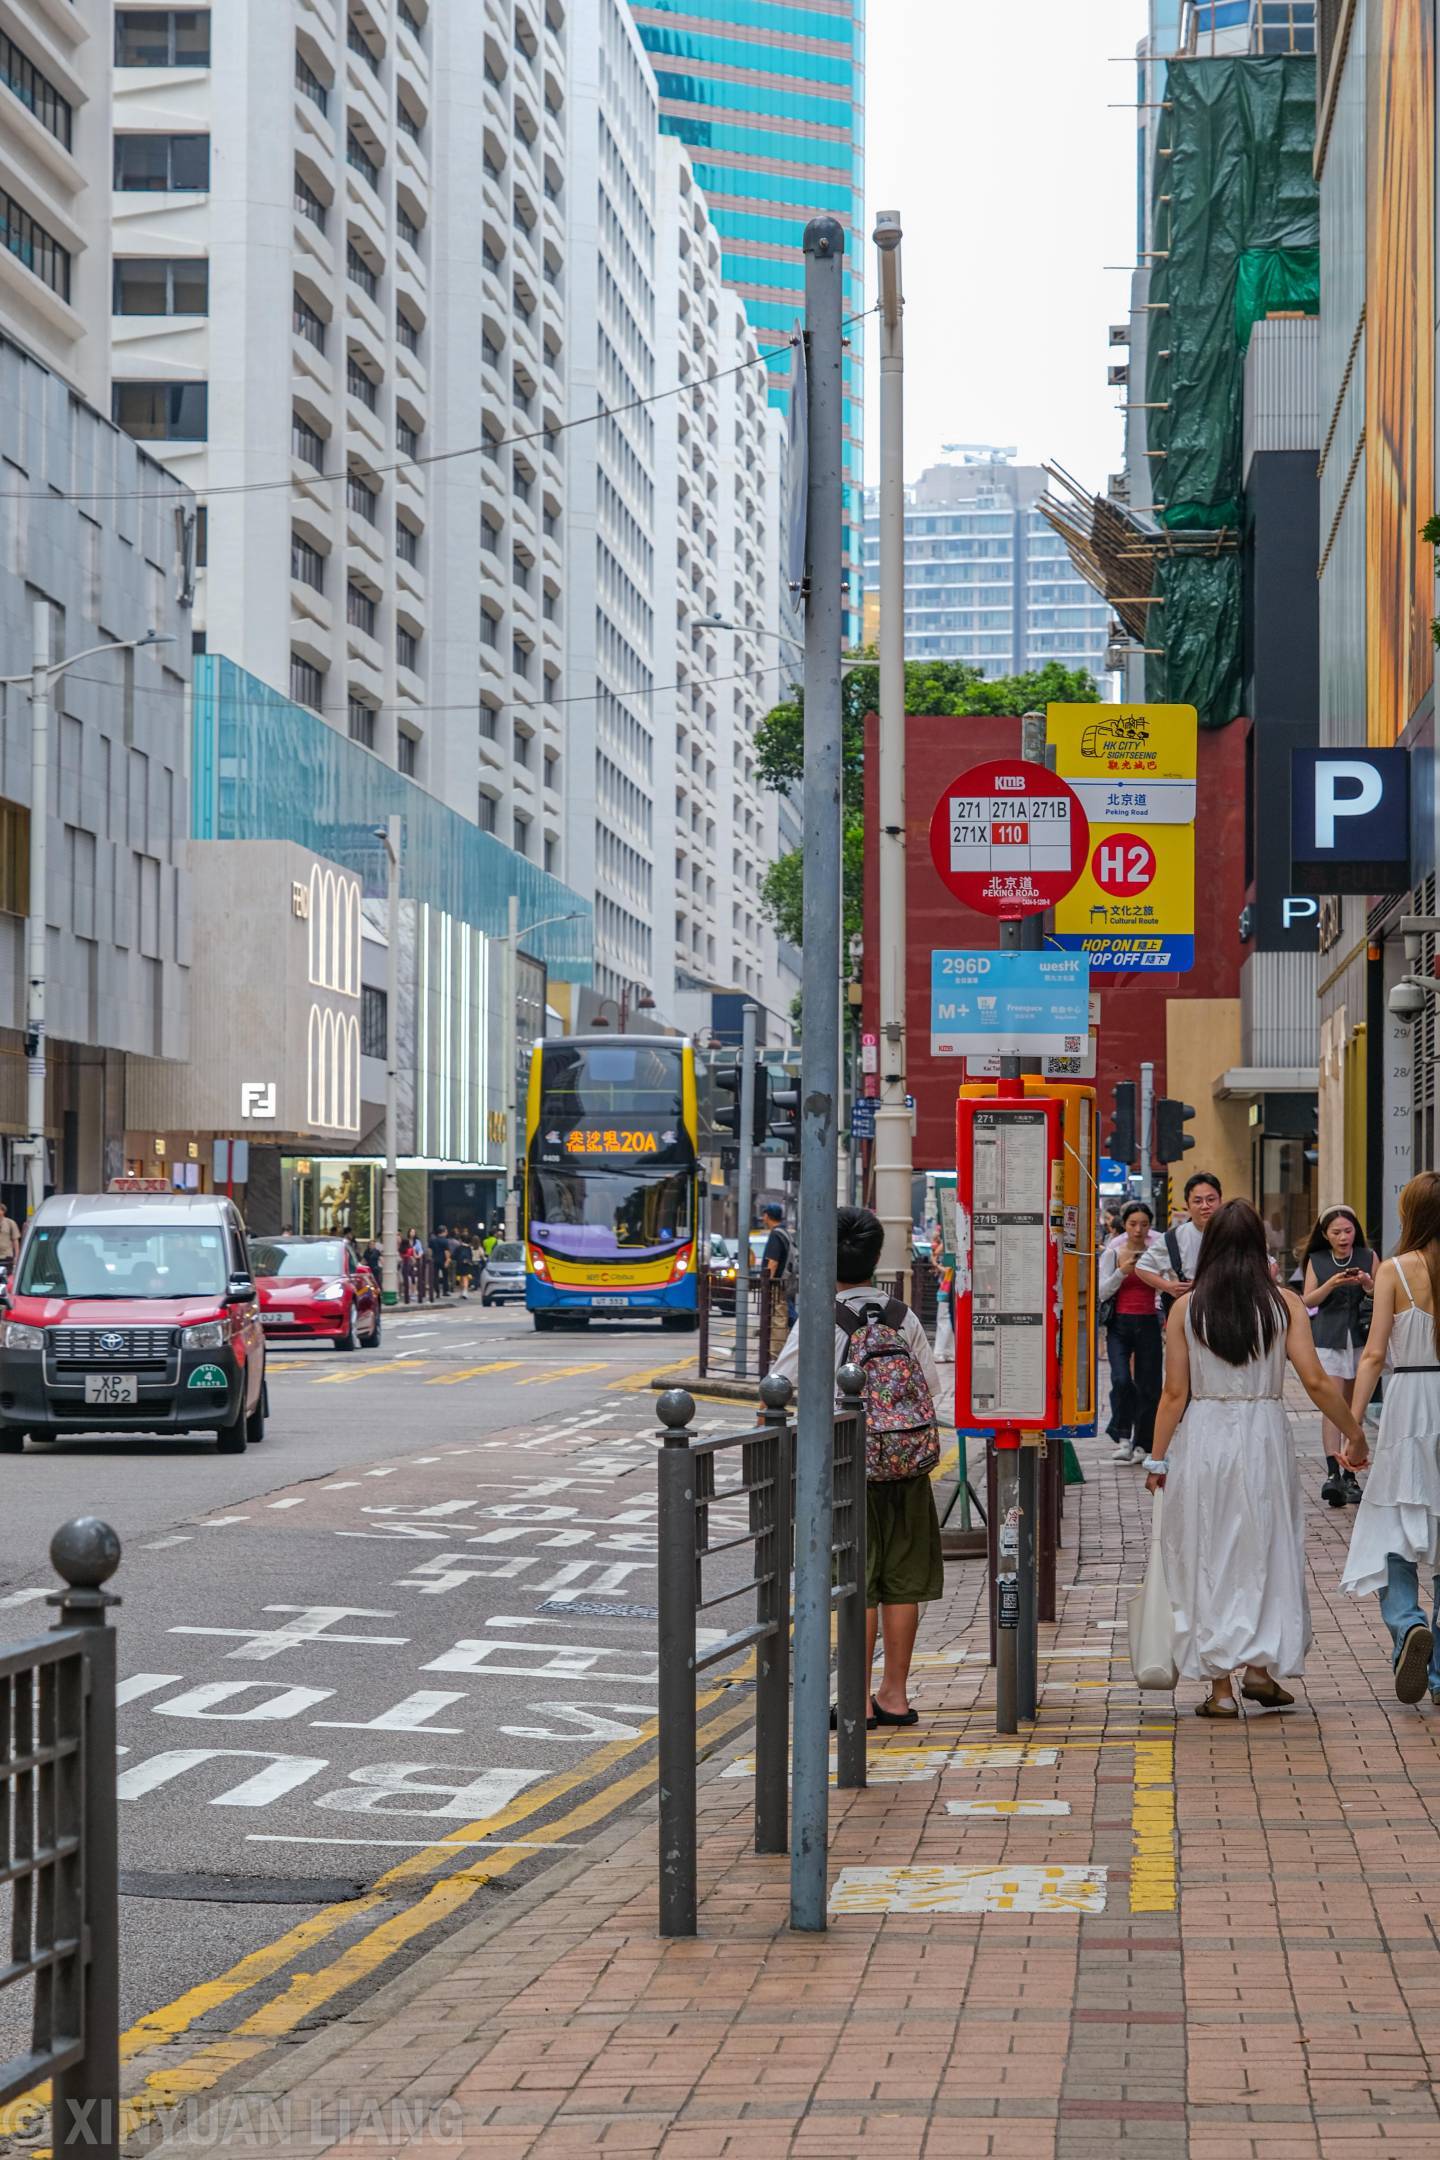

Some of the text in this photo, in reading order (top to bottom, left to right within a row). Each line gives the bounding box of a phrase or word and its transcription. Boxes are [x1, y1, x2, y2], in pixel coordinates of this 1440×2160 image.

[1103, 741, 1141, 750] HK CITY
[1107, 751, 1157, 759] SIGHTSEEING
[994, 776, 1026, 790] KMB
[1107, 793, 1147, 806] 北京道
[1315, 761, 1383, 848] P
[958, 802, 1067, 818] 271 271A 271B
[1105, 808, 1149, 817] Peking Road
[953, 825, 1022, 843] 271X 110
[1100, 845, 1150, 883] H2
[989, 876, 1033, 890] 北京道
[982, 889, 1040, 897] PEKING ROAD
[1110, 905, 1154, 916] 文化之旅
[1283, 897, 1321, 928] P
[1110, 917, 1159, 925] Cultural Route
[1081, 939, 1112, 951] HOP
[1111, 939, 1132, 951] ON
[1113, 953, 1141, 965] OFF
[942, 957, 991, 974] 296D
[977, 1114, 994, 1123] 271
[621, 1131, 657, 1152] 20A
[114, 1179, 167, 1191] TAXI
[974, 1215, 998, 1223] 271B
[261, 1313, 283, 1322] DJ 2
[973, 1315, 997, 1324] 271X
[204, 1372, 212, 1380] 4
[101, 1376, 122, 1389] XP
[92, 1389, 131, 1402] 7192
[116, 1745, 555, 1818] BU
